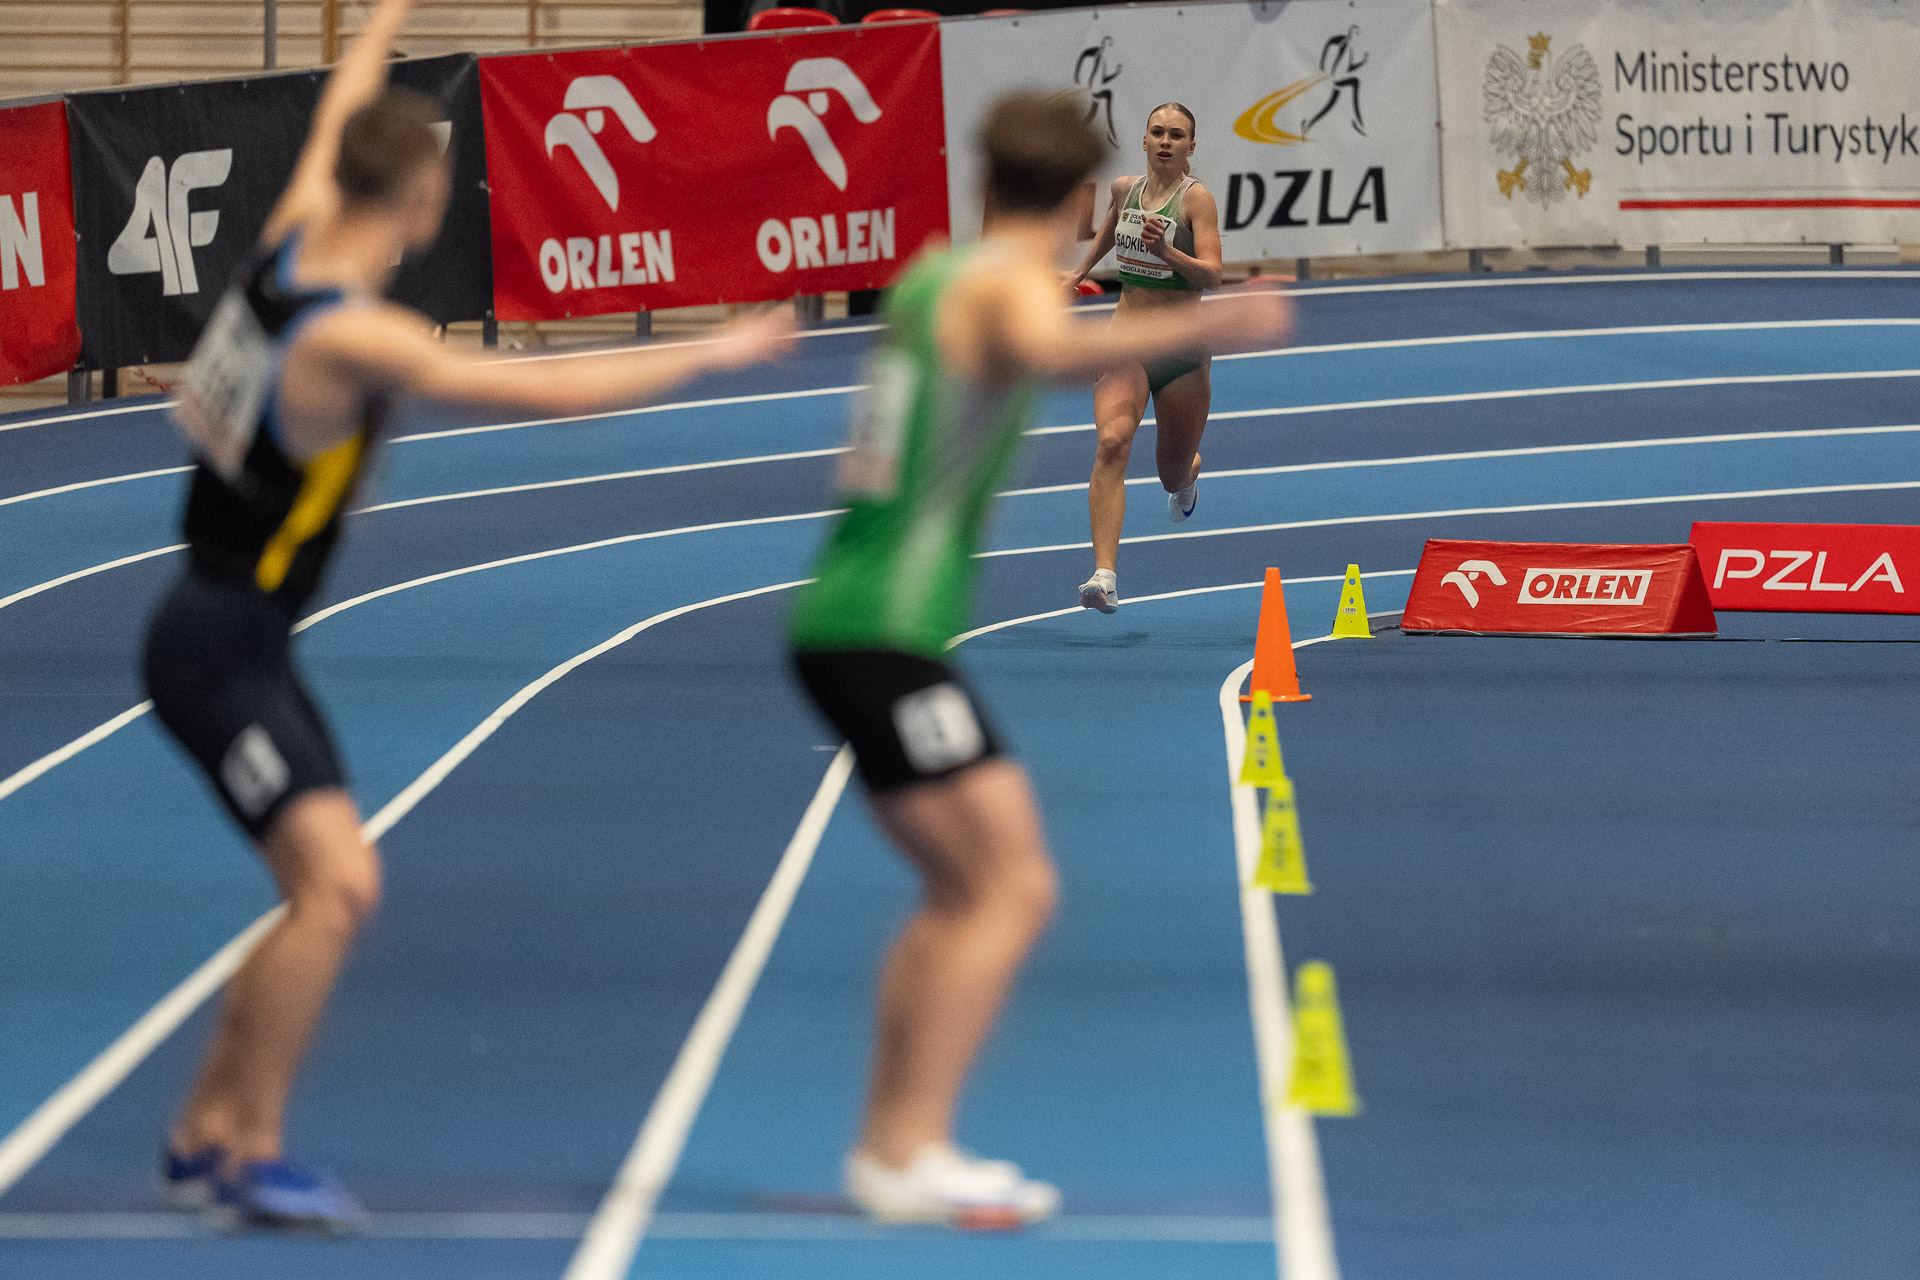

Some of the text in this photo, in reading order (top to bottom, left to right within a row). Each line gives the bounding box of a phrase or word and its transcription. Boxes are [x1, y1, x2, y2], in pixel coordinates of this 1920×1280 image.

[1616, 50, 1849, 93] Ministerstwo
[1615, 112, 1918, 164] Sportu i Turystyk
[108, 148, 233, 296] 4F
[1225, 166, 1388, 231] DZLA
[539, 229, 675, 293] ORLEN
[756, 207, 895, 274] ORLEN
[1147, 269, 1162, 277] 2025
[1527, 573, 1643, 600] ORLEN
[1712, 548, 1905, 593] PZLA
